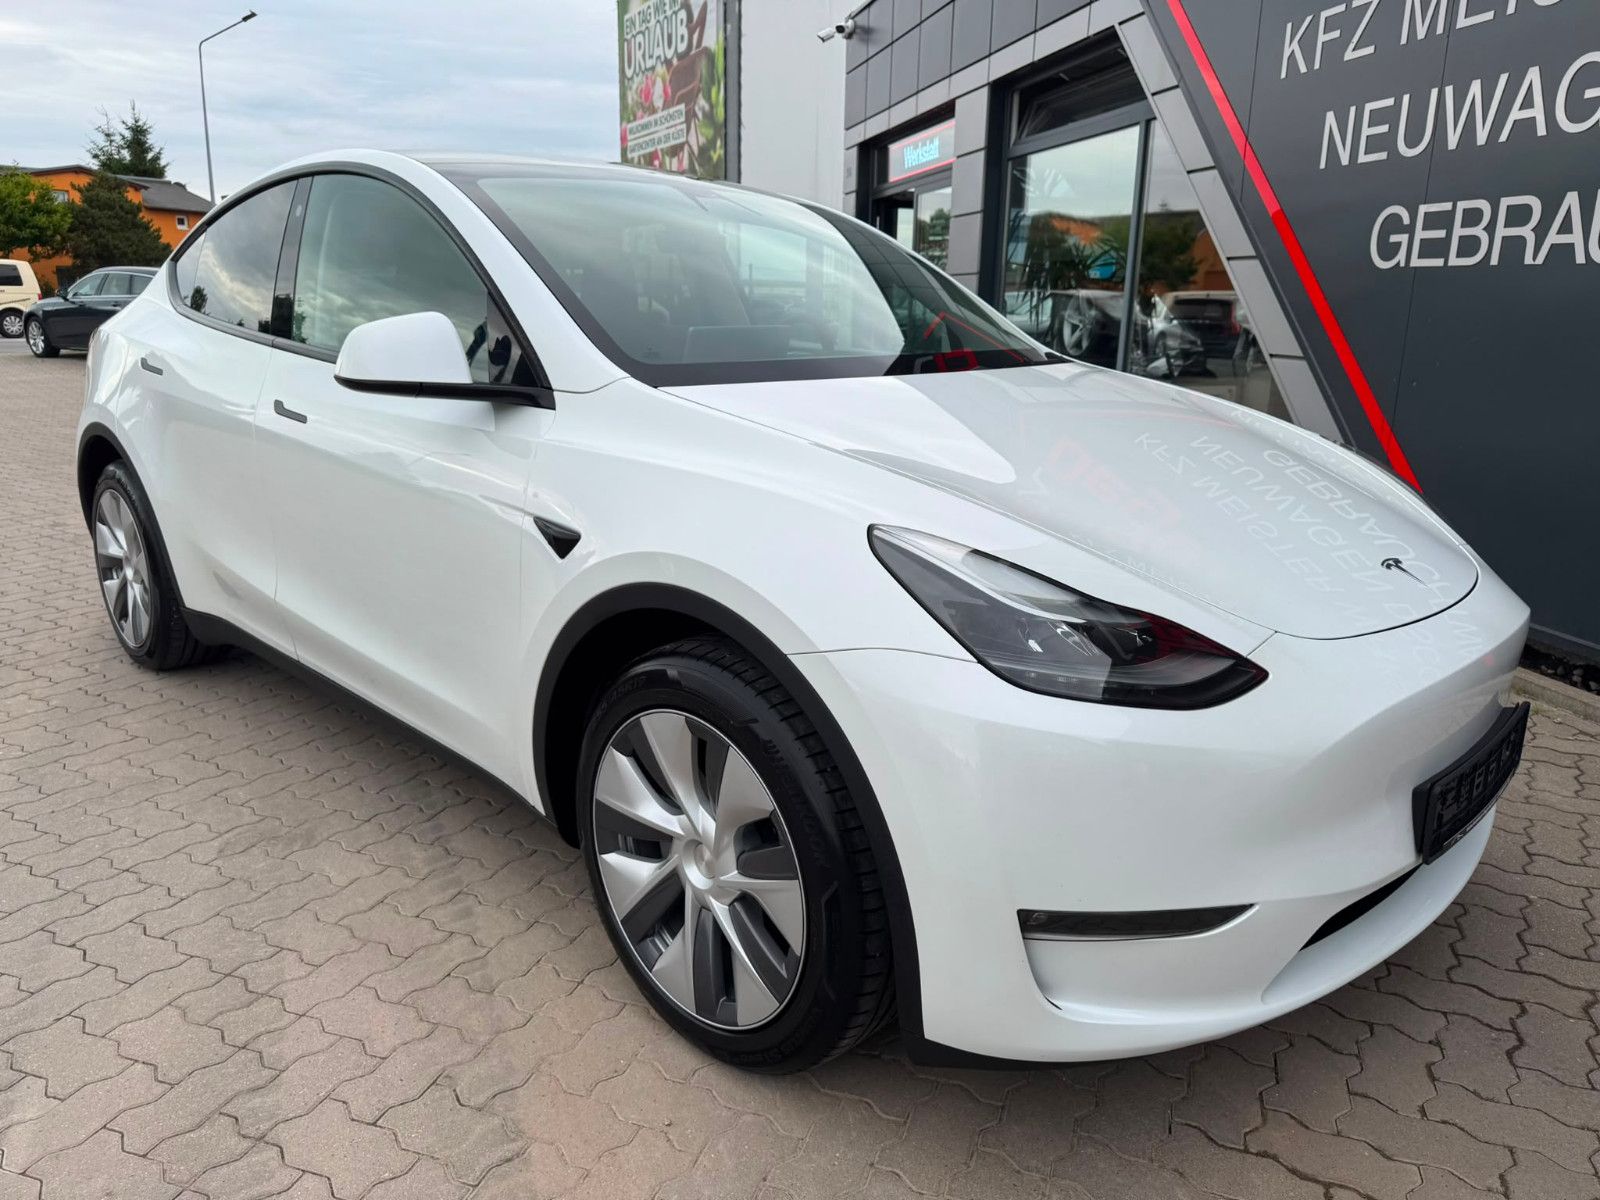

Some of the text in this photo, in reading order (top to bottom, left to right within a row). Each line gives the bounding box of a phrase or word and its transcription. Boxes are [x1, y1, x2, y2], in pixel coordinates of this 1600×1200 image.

[624, 8, 689, 79] URLAUB
[638, 5, 652, 28] TAG
[1280, 0, 1381, 80] KFZ
[1319, 51, 1600, 170] NEUWAG
[1370, 188, 1600, 270] GEBRA
